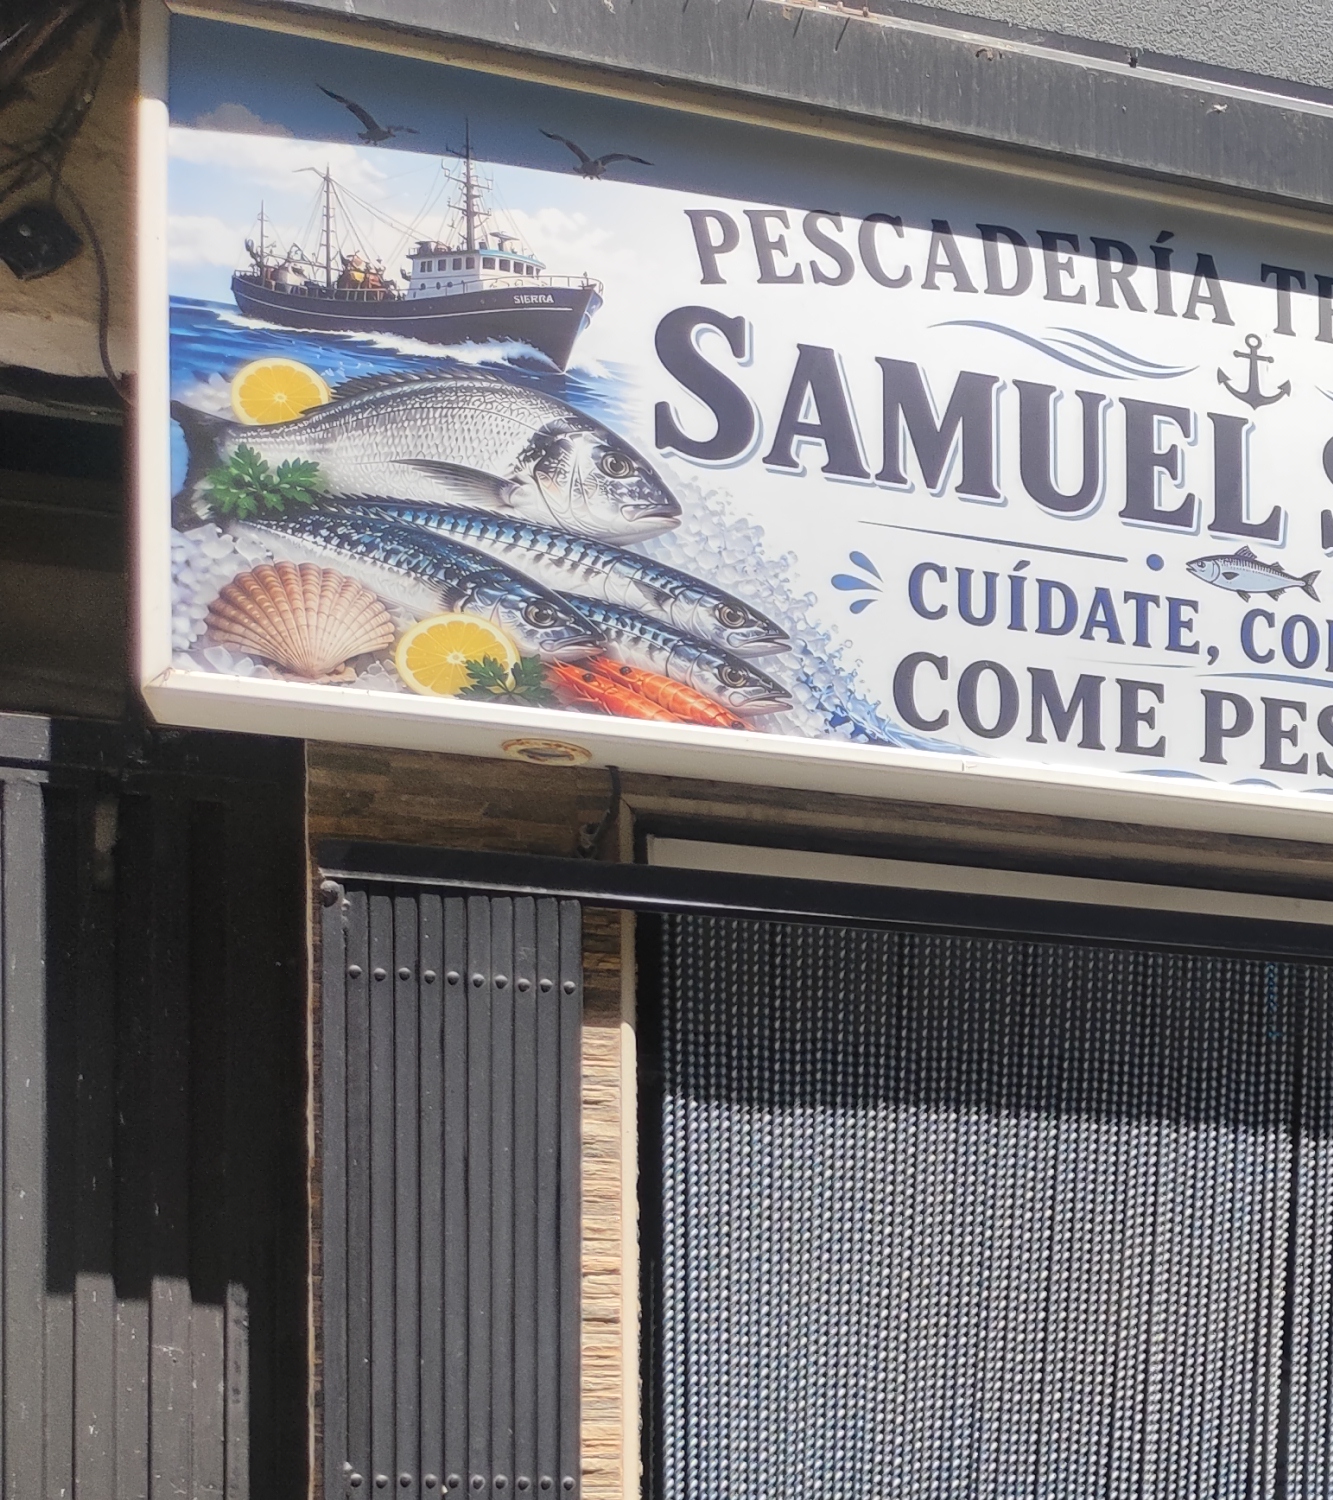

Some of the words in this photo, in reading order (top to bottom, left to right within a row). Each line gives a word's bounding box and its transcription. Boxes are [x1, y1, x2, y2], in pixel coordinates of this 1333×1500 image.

[513, 294, 555, 304] SIERRA
[684, 208, 1236, 326] PESCADERÍA
[653, 305, 1290, 545] SAMUEL
[908, 560, 1220, 666] CUÍDATE,
[892, 651, 1167, 758] COME
